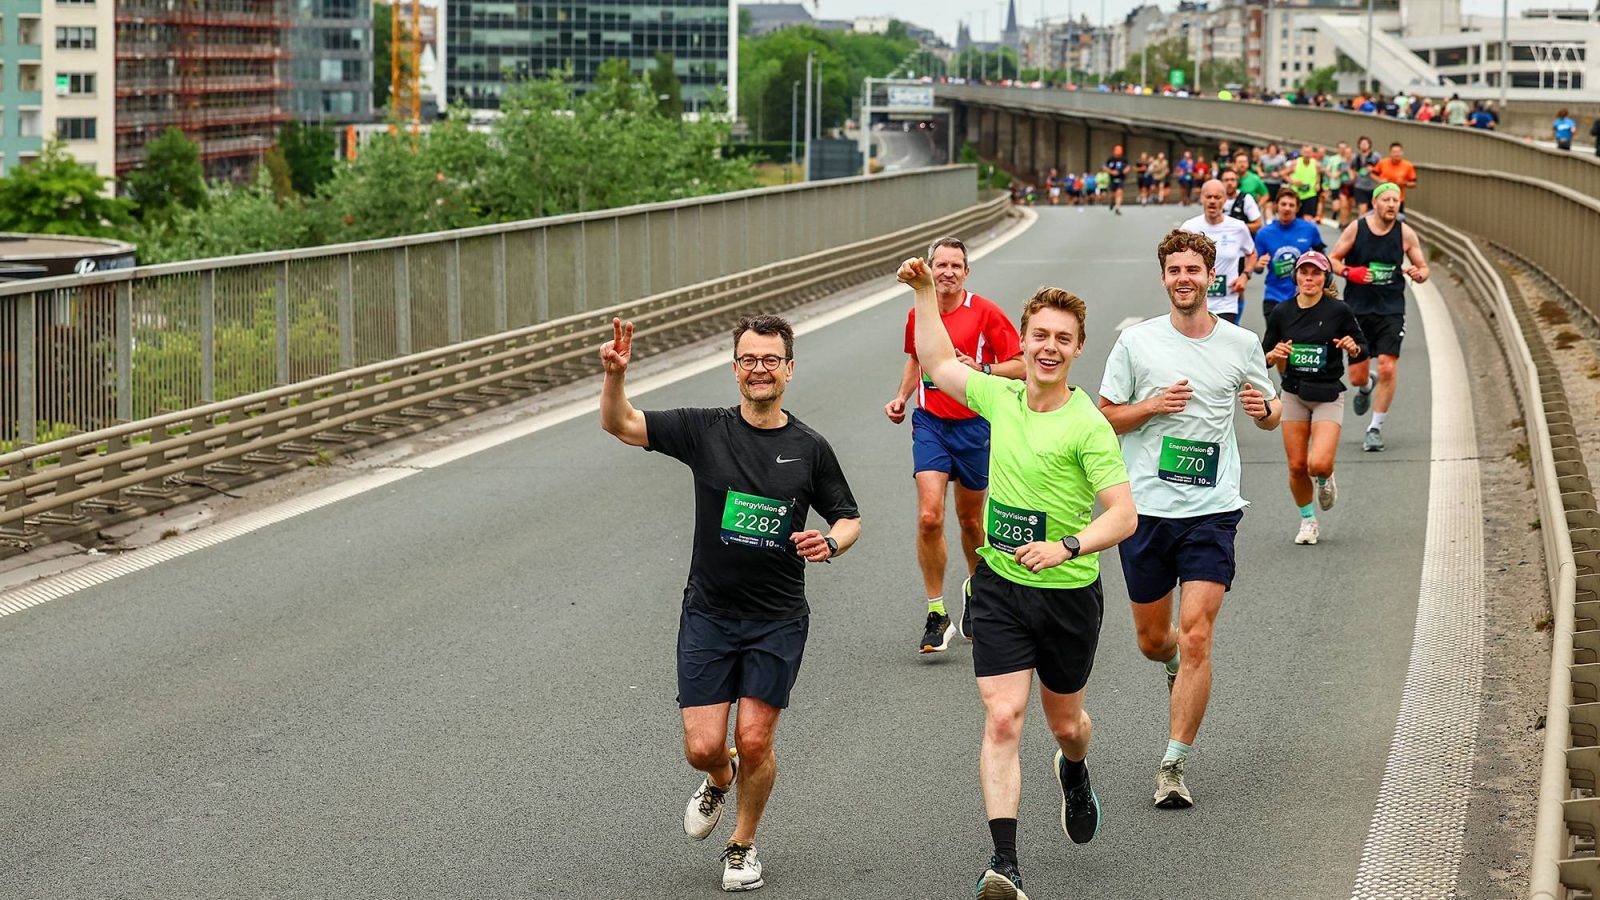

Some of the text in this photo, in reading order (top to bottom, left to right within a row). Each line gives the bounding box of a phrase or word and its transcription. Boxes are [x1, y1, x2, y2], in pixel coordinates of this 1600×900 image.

[1294, 354, 1320, 365] 2844
[1168, 442, 1207, 453] EnergyVision
[1176, 455, 1205, 472] 770
[1198, 477, 1206, 485] 10
[734, 498, 778, 513] EnergyVision
[992, 506, 1028, 522] EnergyVision
[734, 511, 781, 534] 2282
[994, 520, 1034, 543] 2283
